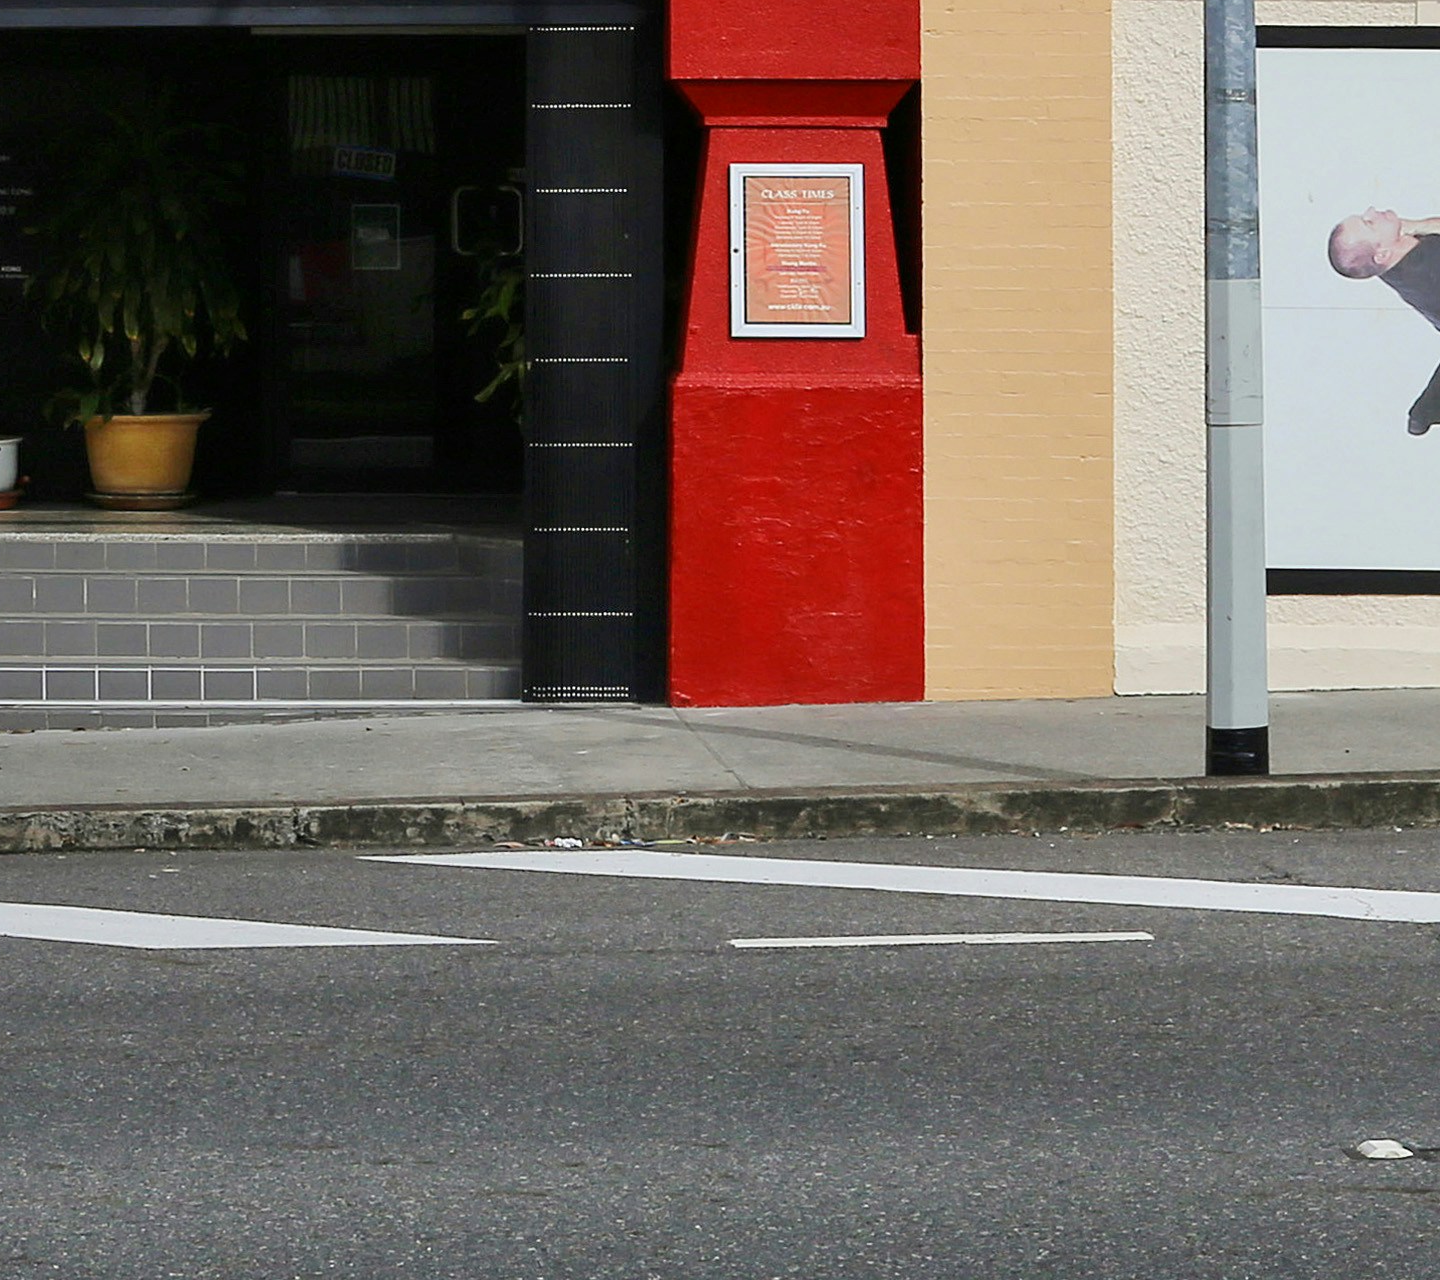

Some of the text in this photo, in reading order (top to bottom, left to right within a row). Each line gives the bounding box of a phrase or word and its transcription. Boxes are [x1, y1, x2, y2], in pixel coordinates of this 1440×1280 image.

[337, 149, 393, 174] CLOSED
[761, 189, 835, 199] CLASS TIMES
